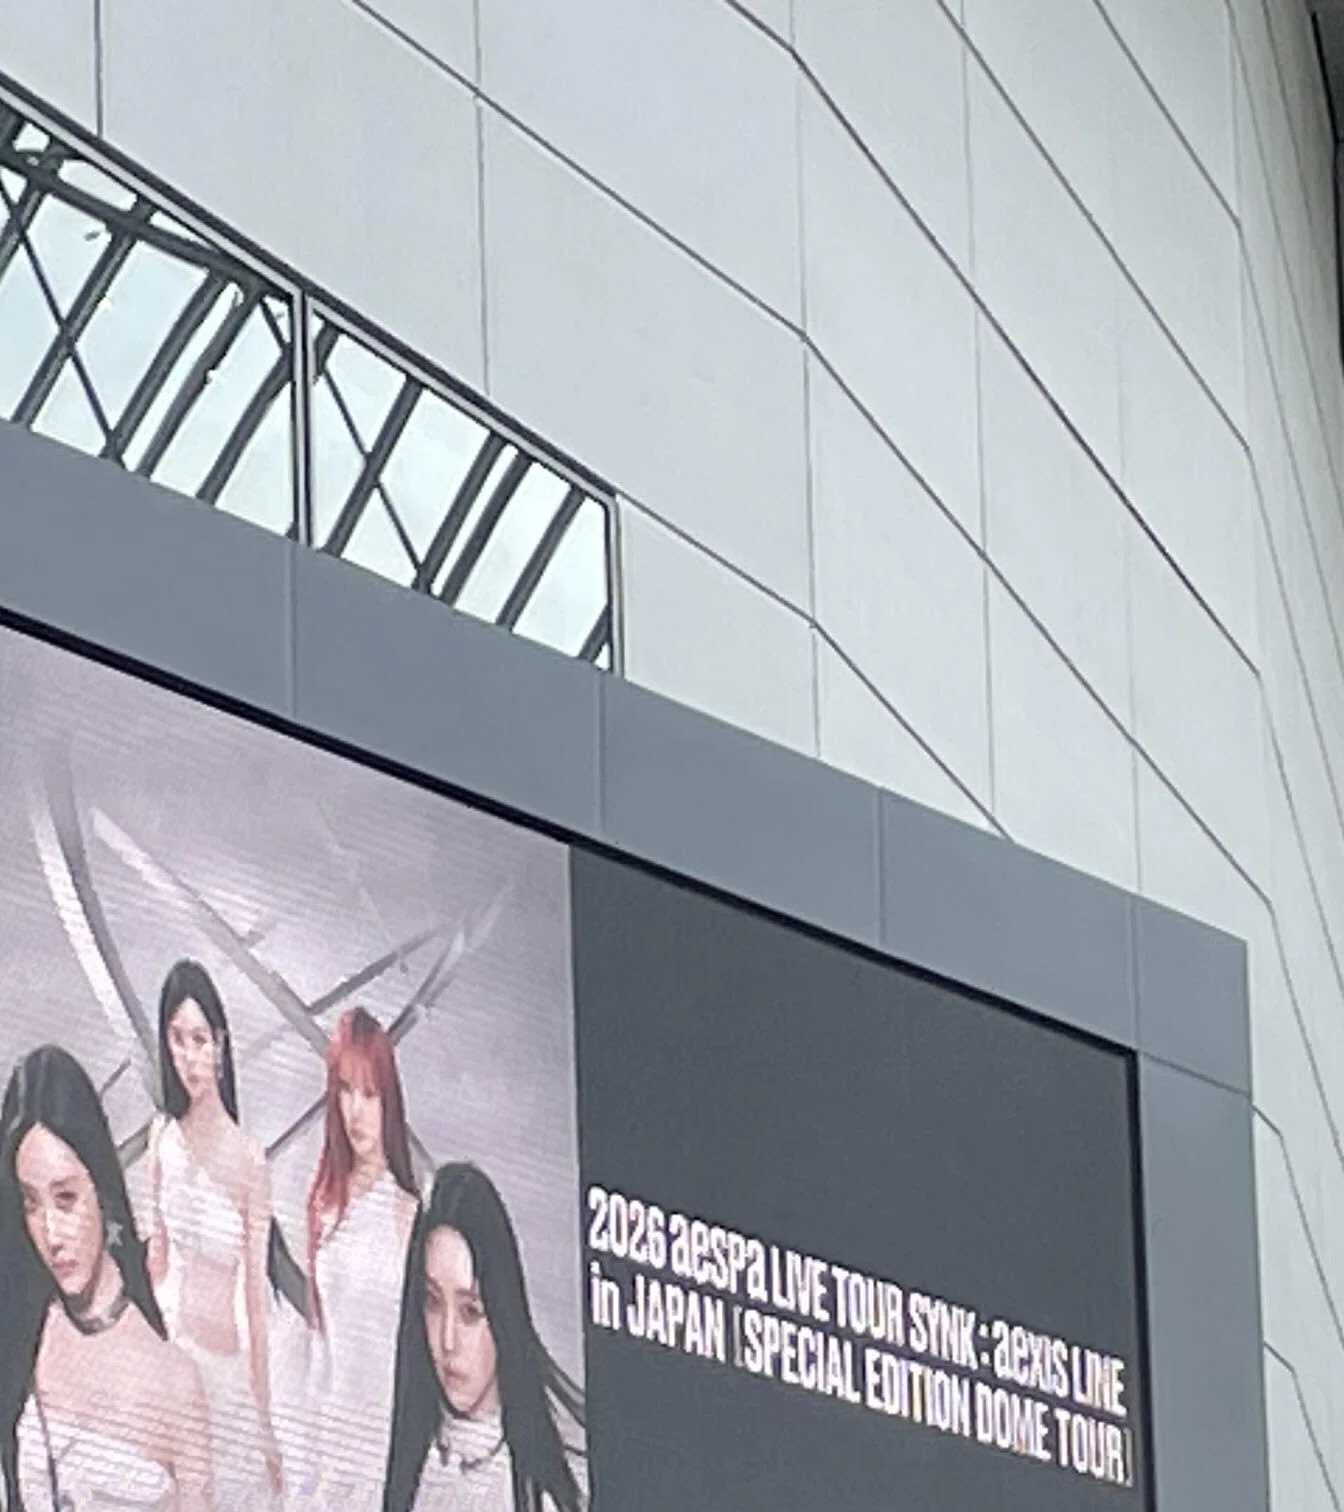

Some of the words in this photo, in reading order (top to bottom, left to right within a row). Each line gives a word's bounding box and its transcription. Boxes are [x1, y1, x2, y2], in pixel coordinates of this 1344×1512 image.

[588, 1186, 667, 1270] 2026
[770, 1245, 830, 1322] LIVE
[831, 1264, 905, 1348] TOUR
[909, 1291, 978, 1370] SYNK
[1071, 1345, 1128, 1418] LINE
[590, 1260, 621, 1330] in
[626, 1273, 726, 1363] JAPAN
[865, 1347, 970, 1438] EDITION
[974, 1380, 1052, 1461] DOME
